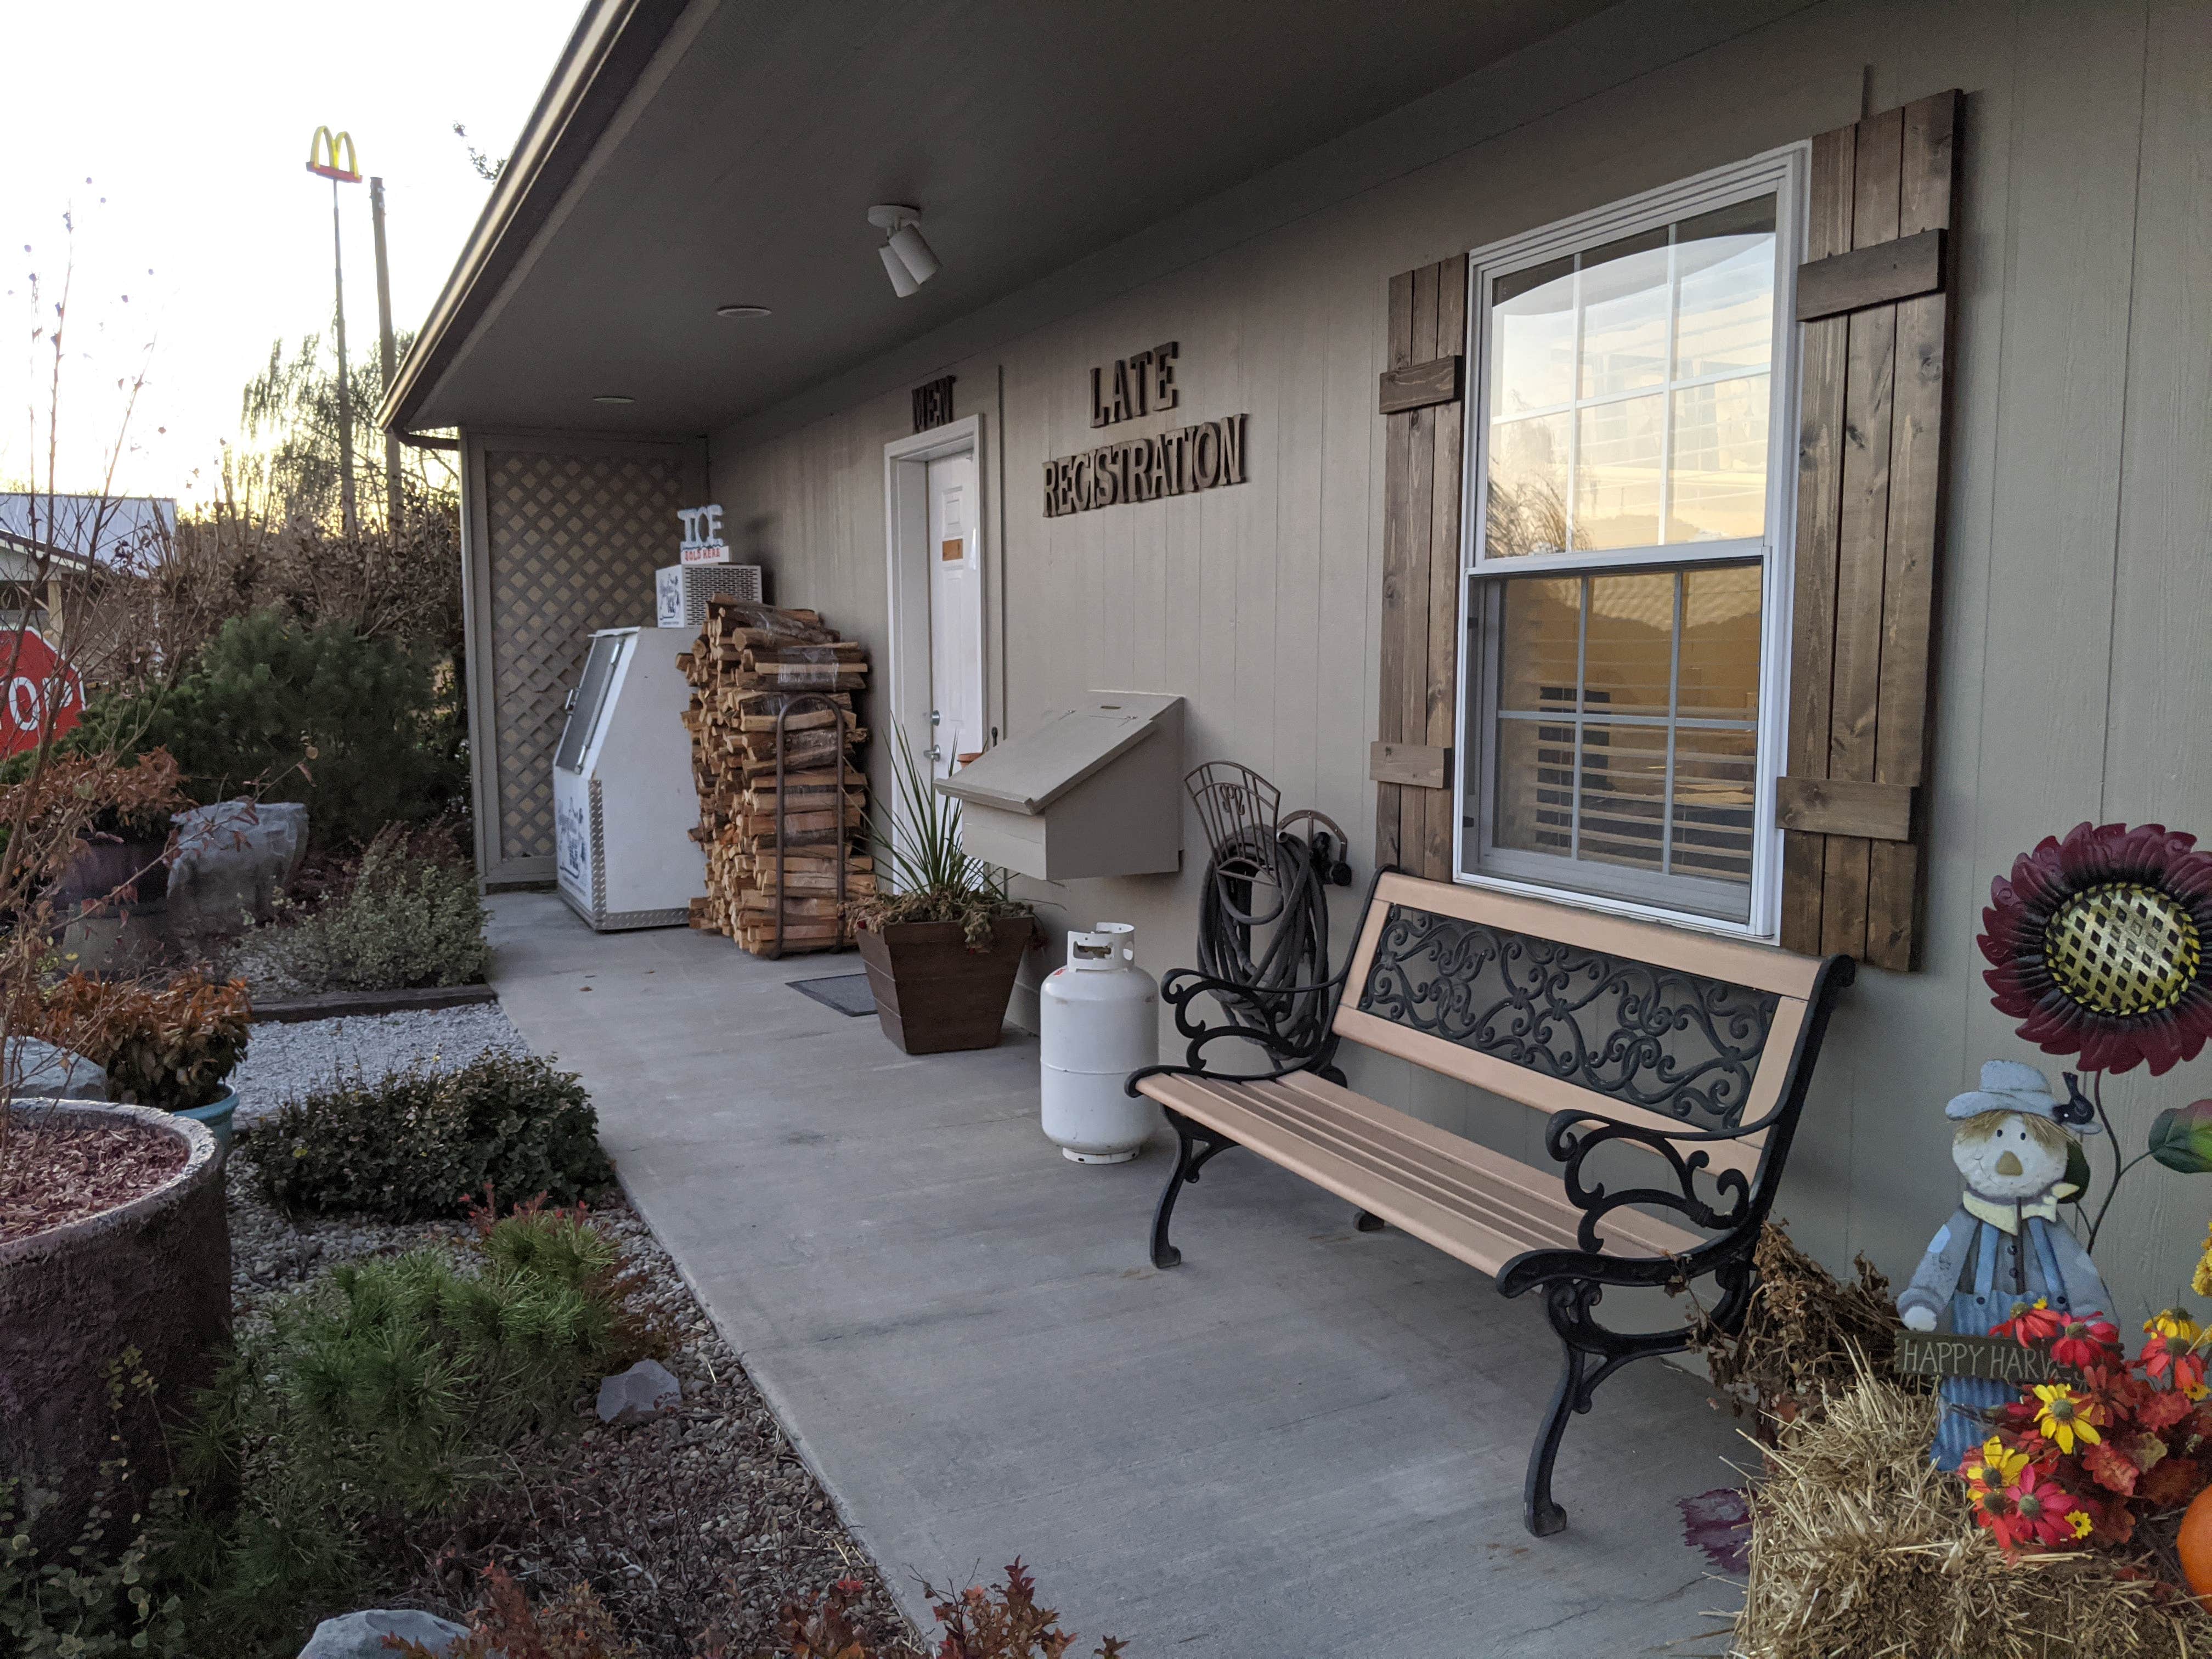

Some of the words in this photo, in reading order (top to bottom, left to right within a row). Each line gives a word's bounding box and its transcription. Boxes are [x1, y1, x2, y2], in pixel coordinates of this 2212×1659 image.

[1090, 342, 1178, 428] LATE
[1042, 413, 1249, 517] REGISTRATION
[677, 504, 723, 547] ICE
[1903, 1339, 1984, 1375] HAPPY
[1990, 1344, 2073, 1381] HARV
